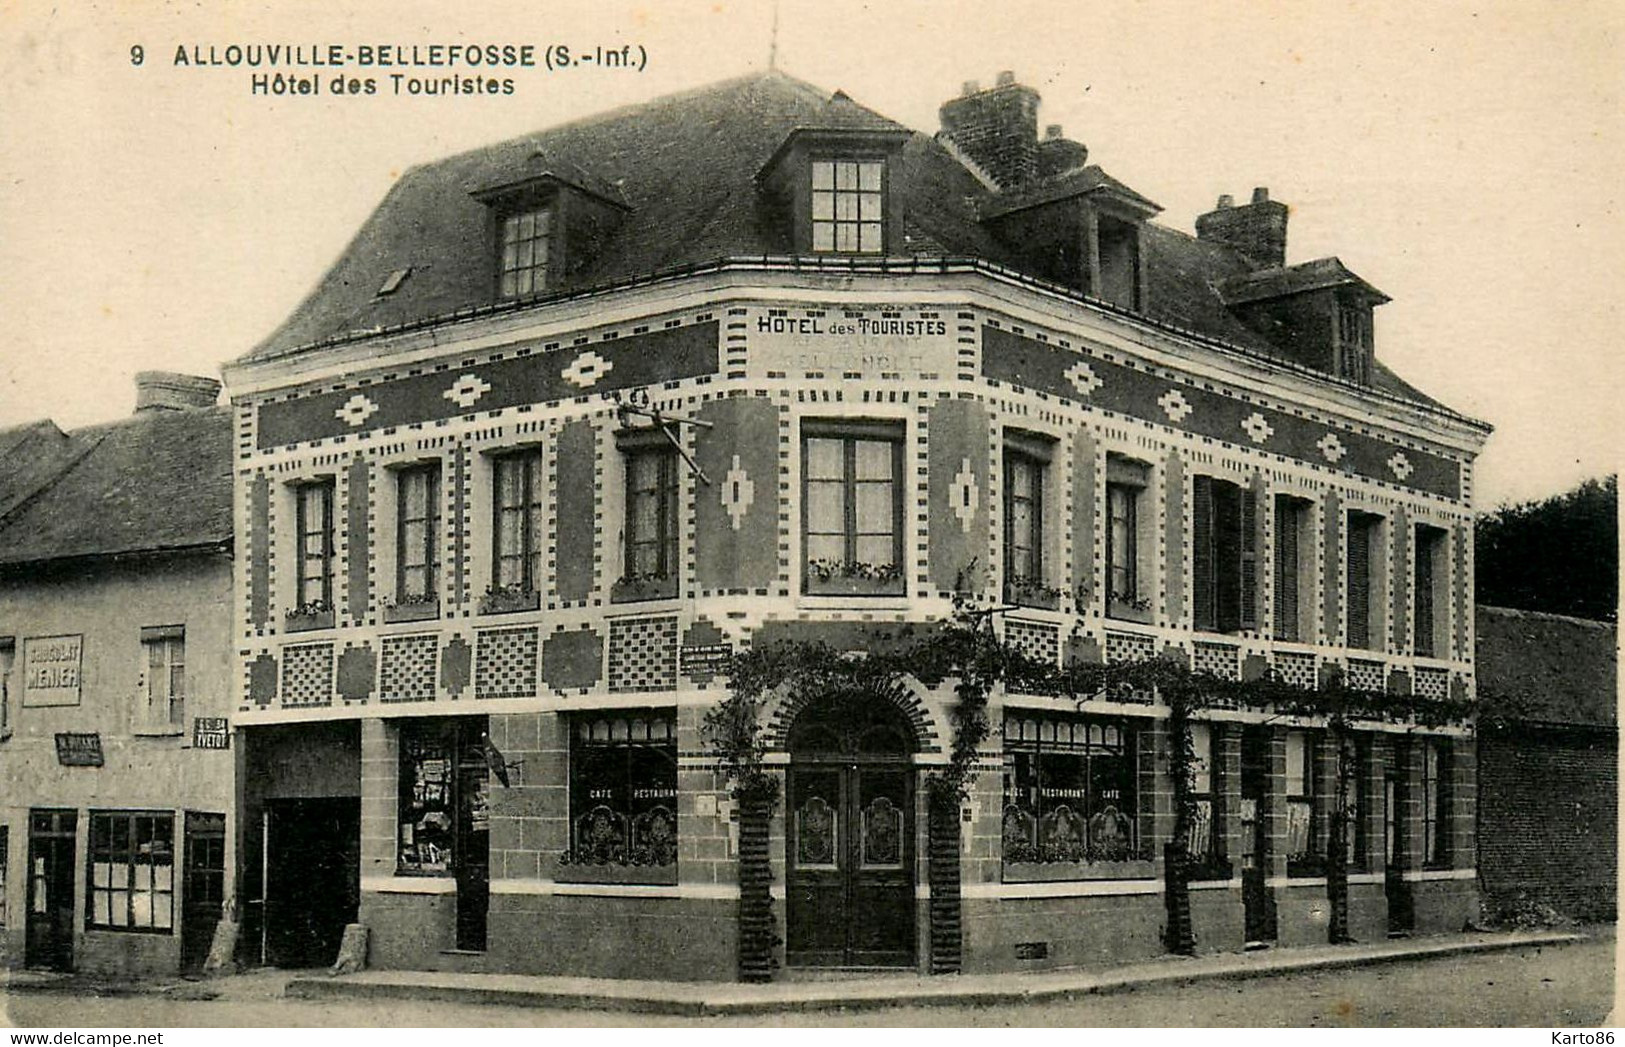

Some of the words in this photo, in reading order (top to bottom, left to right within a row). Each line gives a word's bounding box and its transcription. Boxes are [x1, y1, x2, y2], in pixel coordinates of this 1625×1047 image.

[829, 322, 856, 335] des
[858, 318, 946, 336] TOURISTES
[27, 667, 80, 690] MENIER
